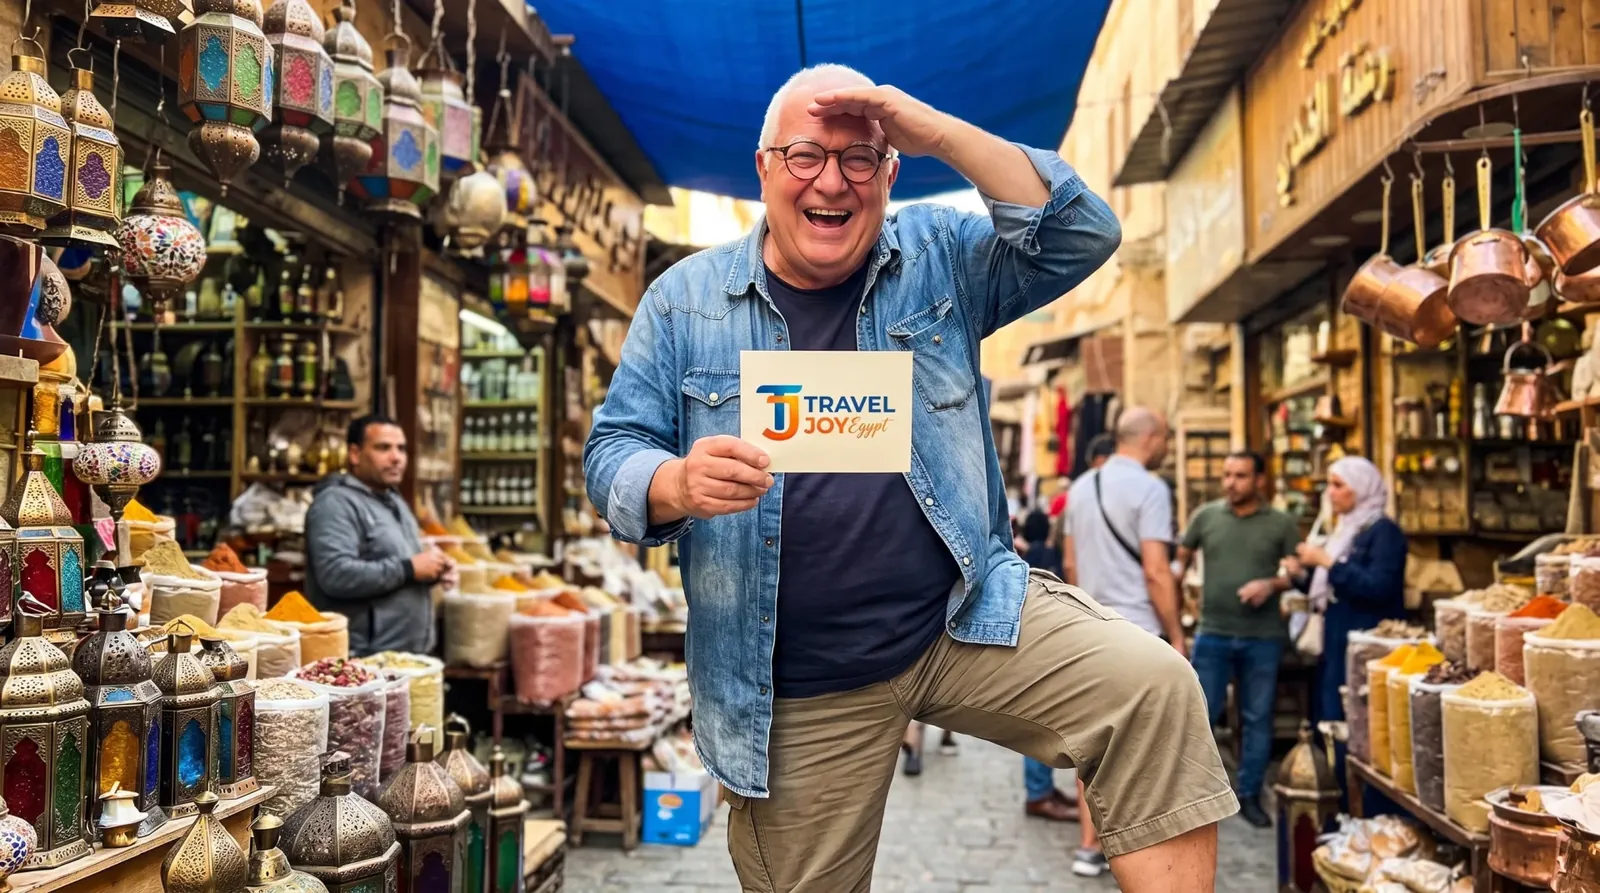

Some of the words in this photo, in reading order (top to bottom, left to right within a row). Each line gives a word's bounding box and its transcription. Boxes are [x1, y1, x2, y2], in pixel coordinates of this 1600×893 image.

[804, 396, 896, 413] TRAVEL
[804, 417, 849, 434] JOY
[848, 416, 895, 439] Egypt
